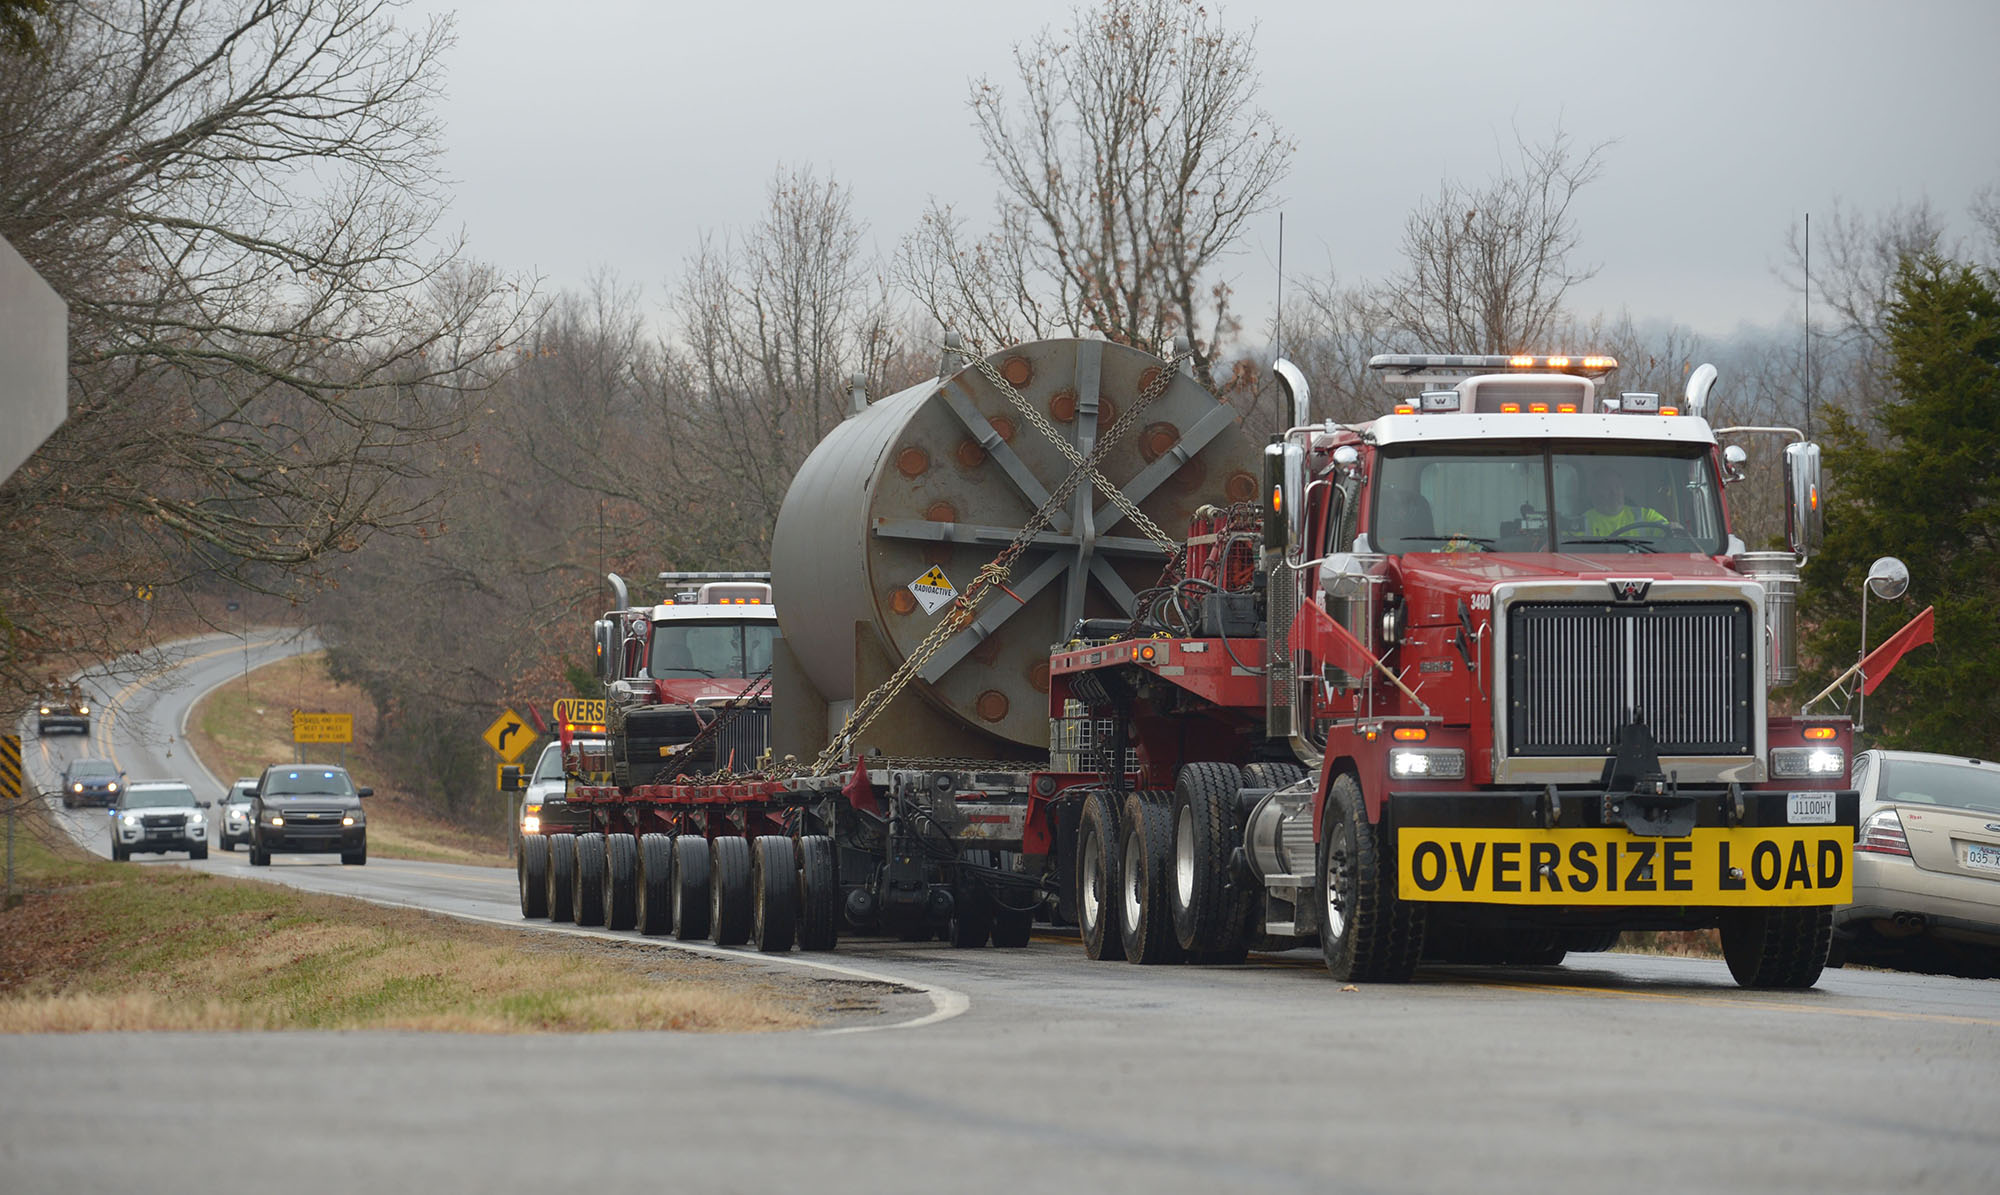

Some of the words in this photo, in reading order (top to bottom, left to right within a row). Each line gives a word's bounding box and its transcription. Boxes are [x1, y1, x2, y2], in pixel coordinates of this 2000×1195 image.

[914, 583, 952, 597] RADIOACTIVE
[1470, 594, 1491, 610] 3480
[1793, 801, 1832, 815] J1100HY
[1969, 851, 1989, 864] 035
[1411, 841, 1694, 893] OVERSIZE
[1718, 840, 1844, 892] LOAD
